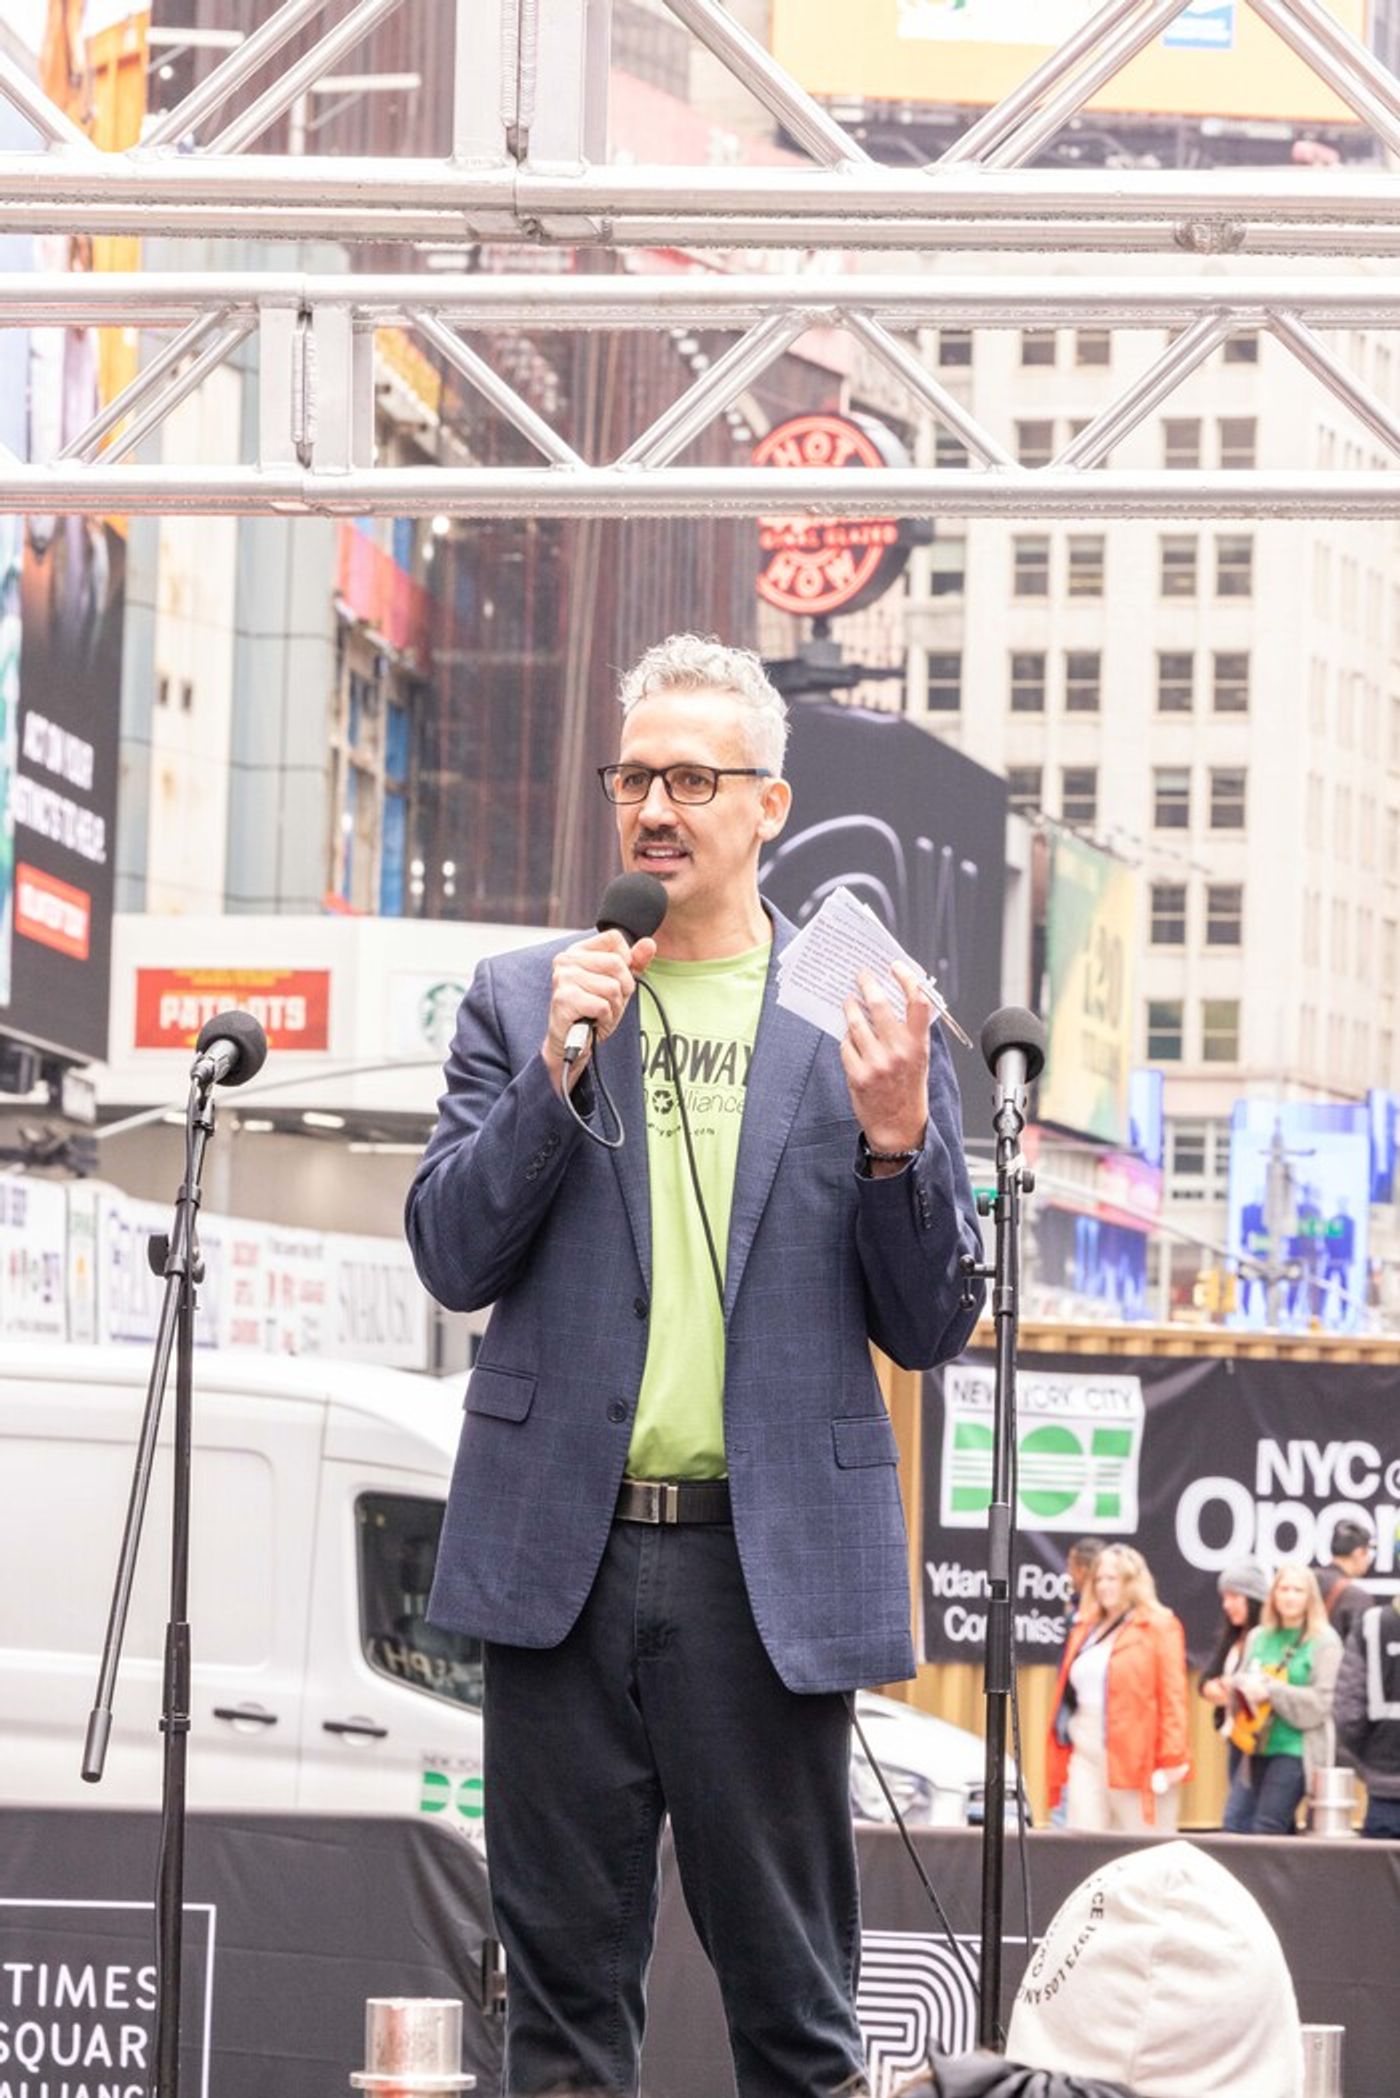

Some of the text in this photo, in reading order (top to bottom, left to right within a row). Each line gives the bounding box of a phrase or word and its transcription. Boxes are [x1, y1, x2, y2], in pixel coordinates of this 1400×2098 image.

[771, 431, 858, 467] HOT
[766, 548, 856, 599] NOW
[158, 993, 307, 1031] PATROTS
[952, 1379, 993, 1404] NE
[1085, 1386, 1133, 1411] CITY
[1256, 1438, 1382, 1499] NYC
[2, 1962, 157, 2011] TIMES
[0, 2021, 148, 2074] QUAR
